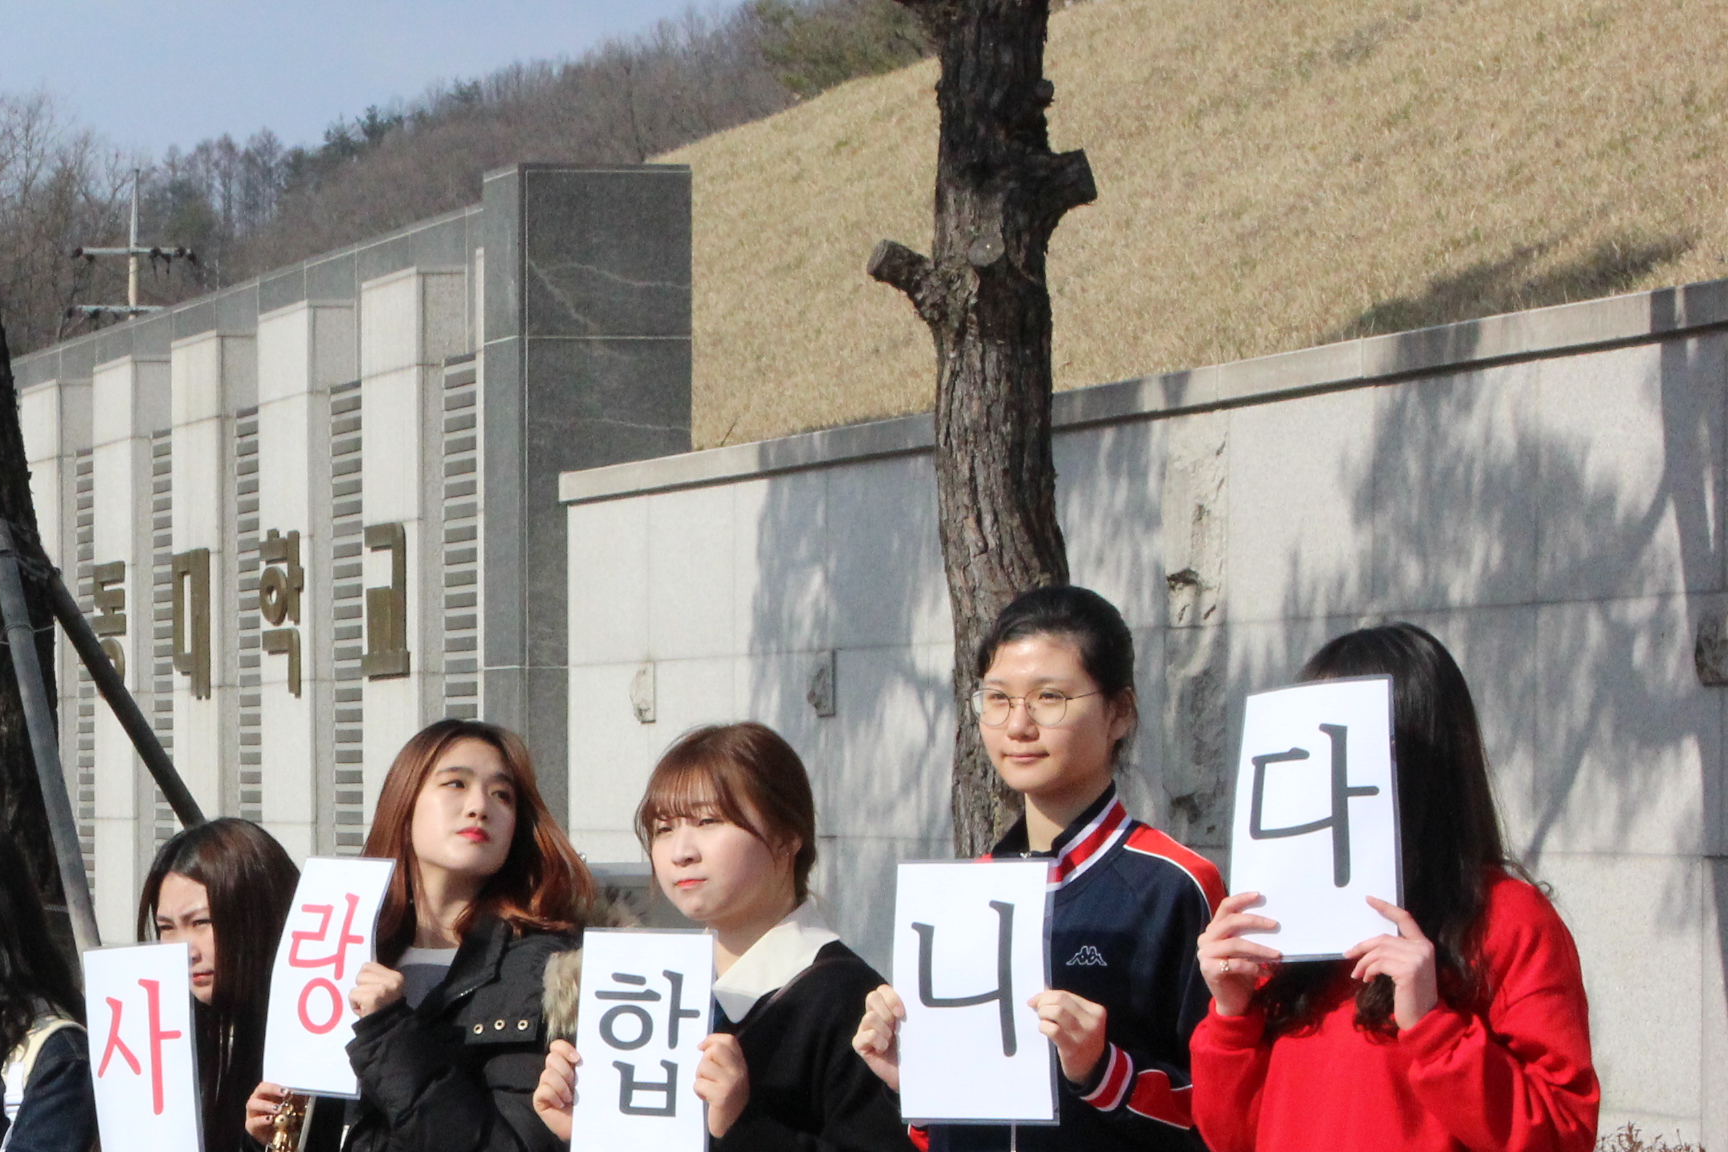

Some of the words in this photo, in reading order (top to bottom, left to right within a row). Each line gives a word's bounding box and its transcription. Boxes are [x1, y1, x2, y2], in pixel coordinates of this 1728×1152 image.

[97, 978, 183, 1115] 사
[288, 891, 365, 1035] 랑
[595, 969, 701, 1118] 합
[910, 900, 1018, 1058] 니
[1249, 723, 1380, 889] 다
